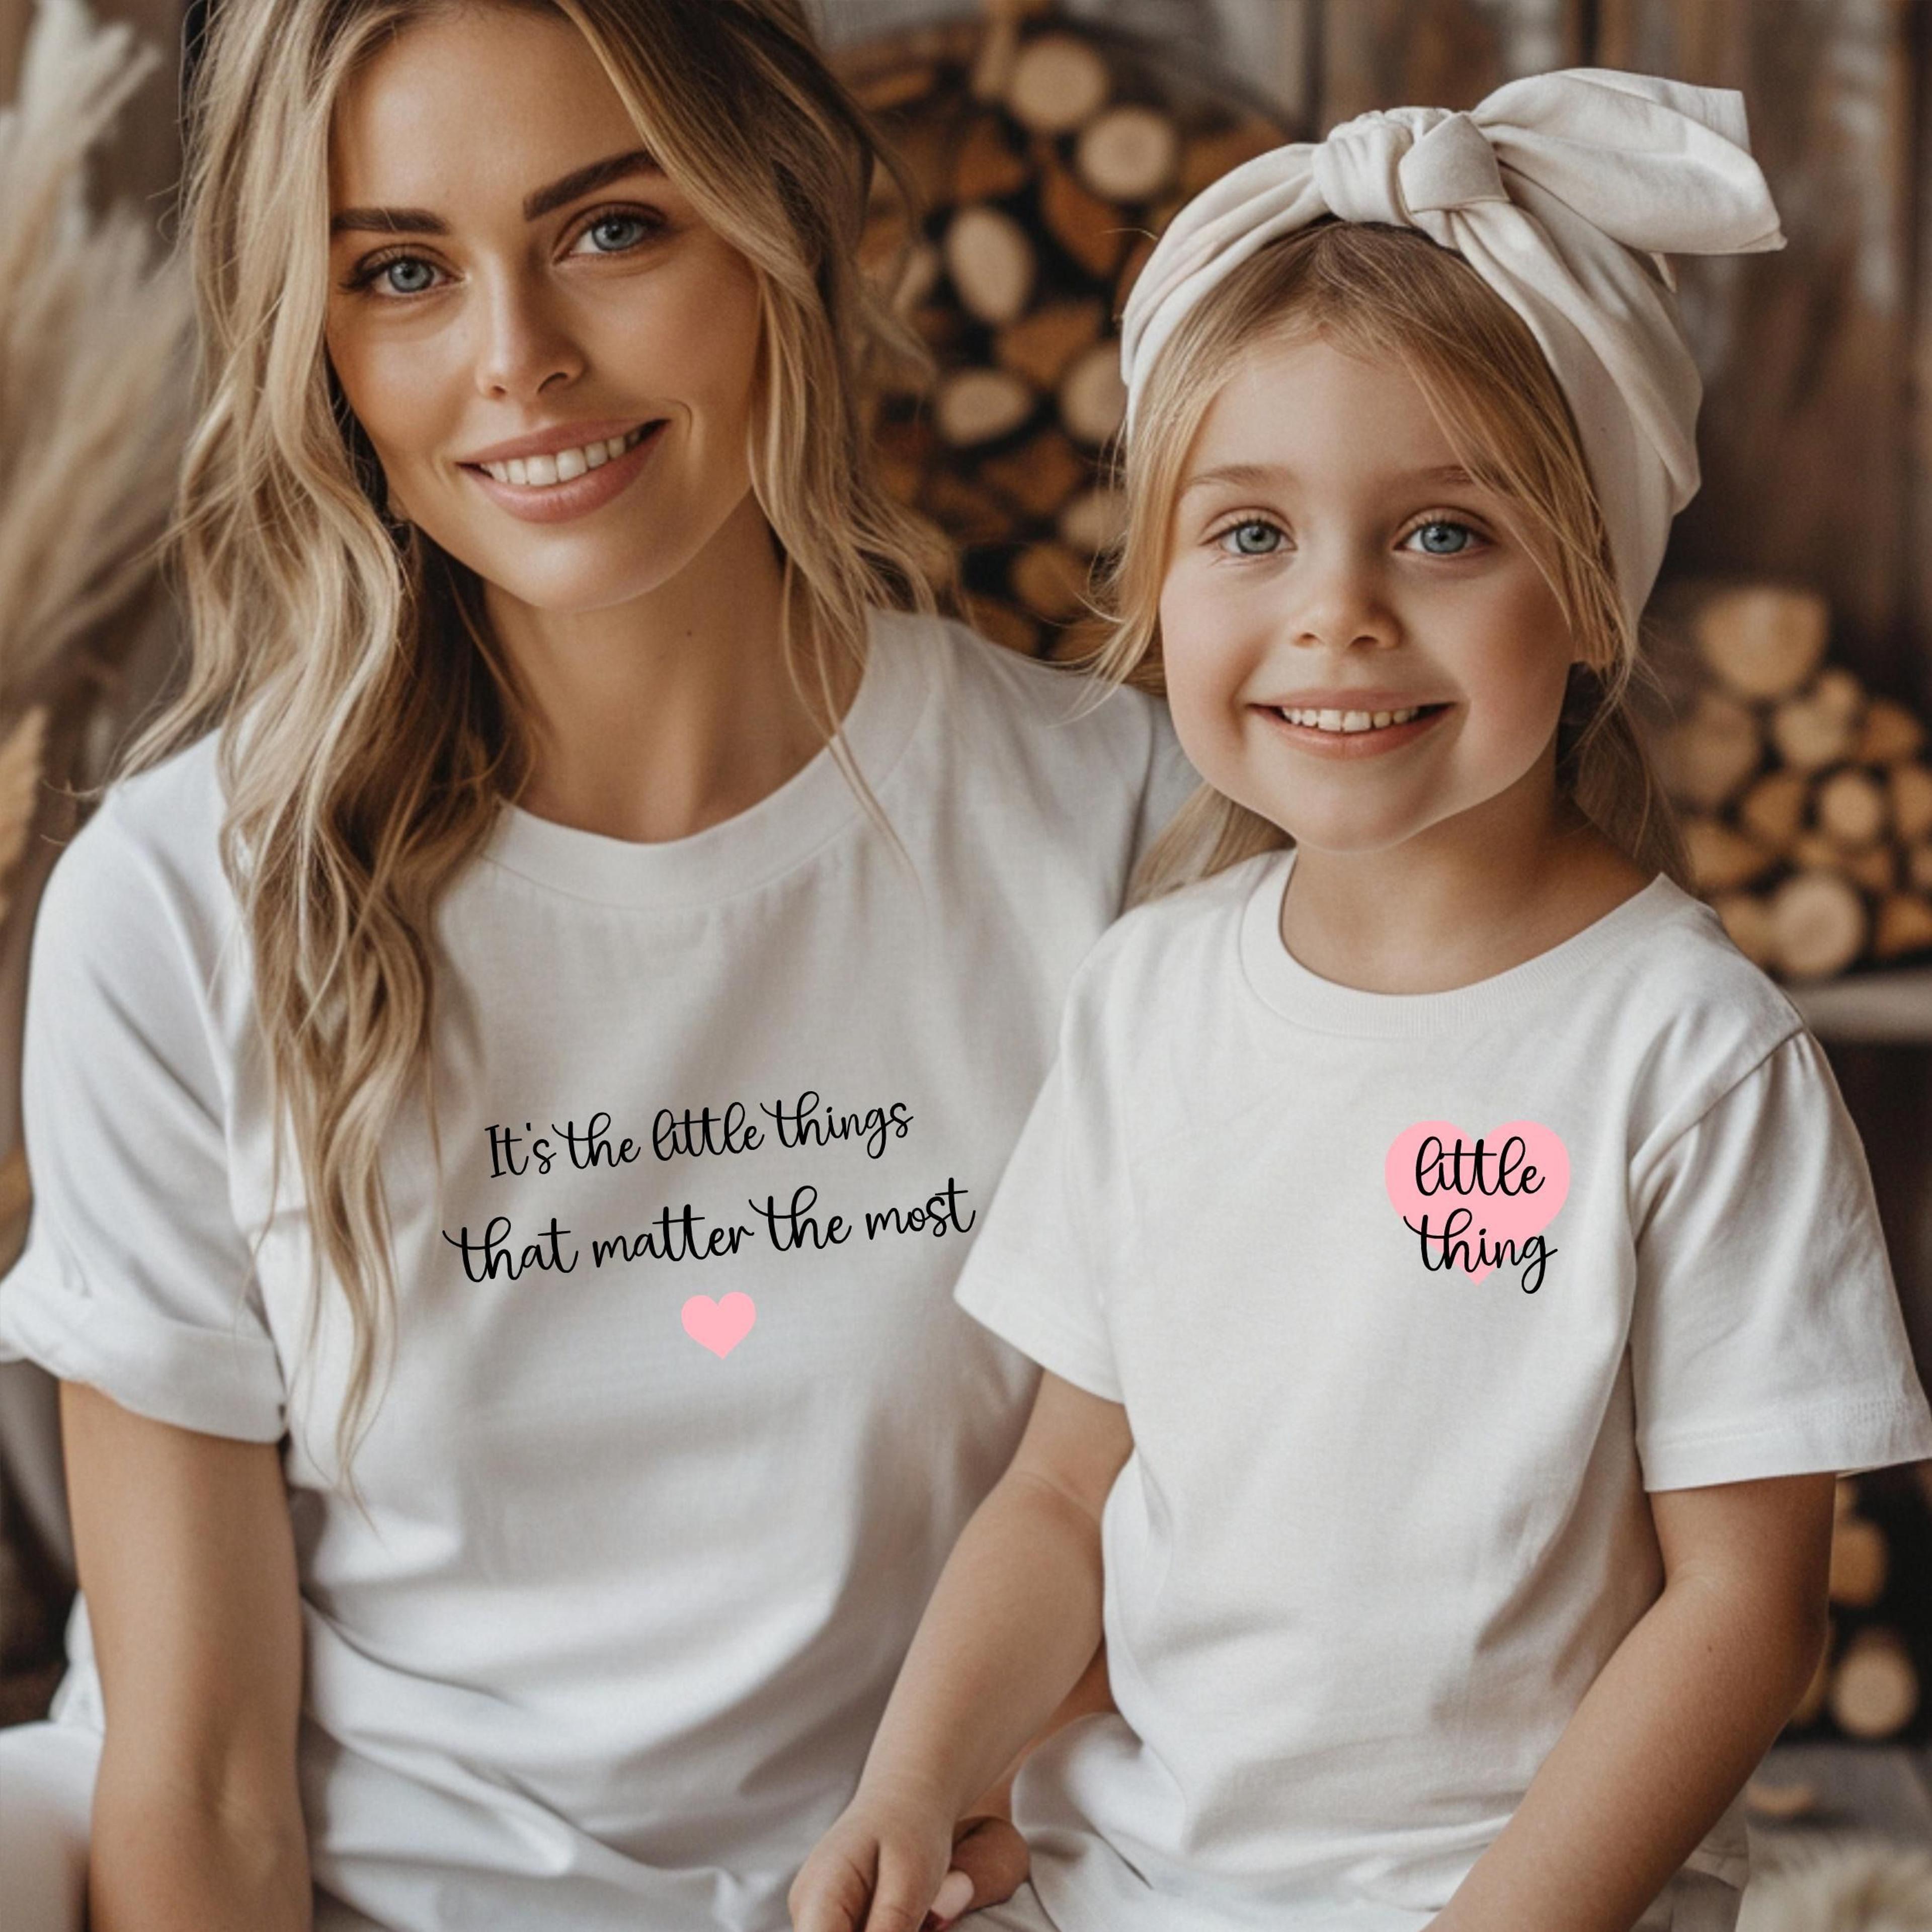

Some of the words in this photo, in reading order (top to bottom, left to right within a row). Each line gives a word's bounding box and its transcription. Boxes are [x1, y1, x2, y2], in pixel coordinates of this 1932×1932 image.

[484, 1122, 557, 1178] It's
[551, 1112, 641, 1169] the
[653, 1101, 765, 1161] little
[760, 1091, 914, 1159] things
[1415, 1136, 1545, 1196] little
[442, 1216, 579, 1282] that
[592, 1204, 755, 1268] matter
[748, 1185, 852, 1252] the
[865, 1177, 976, 1240] most
[1403, 1208, 1558, 1294] thing
